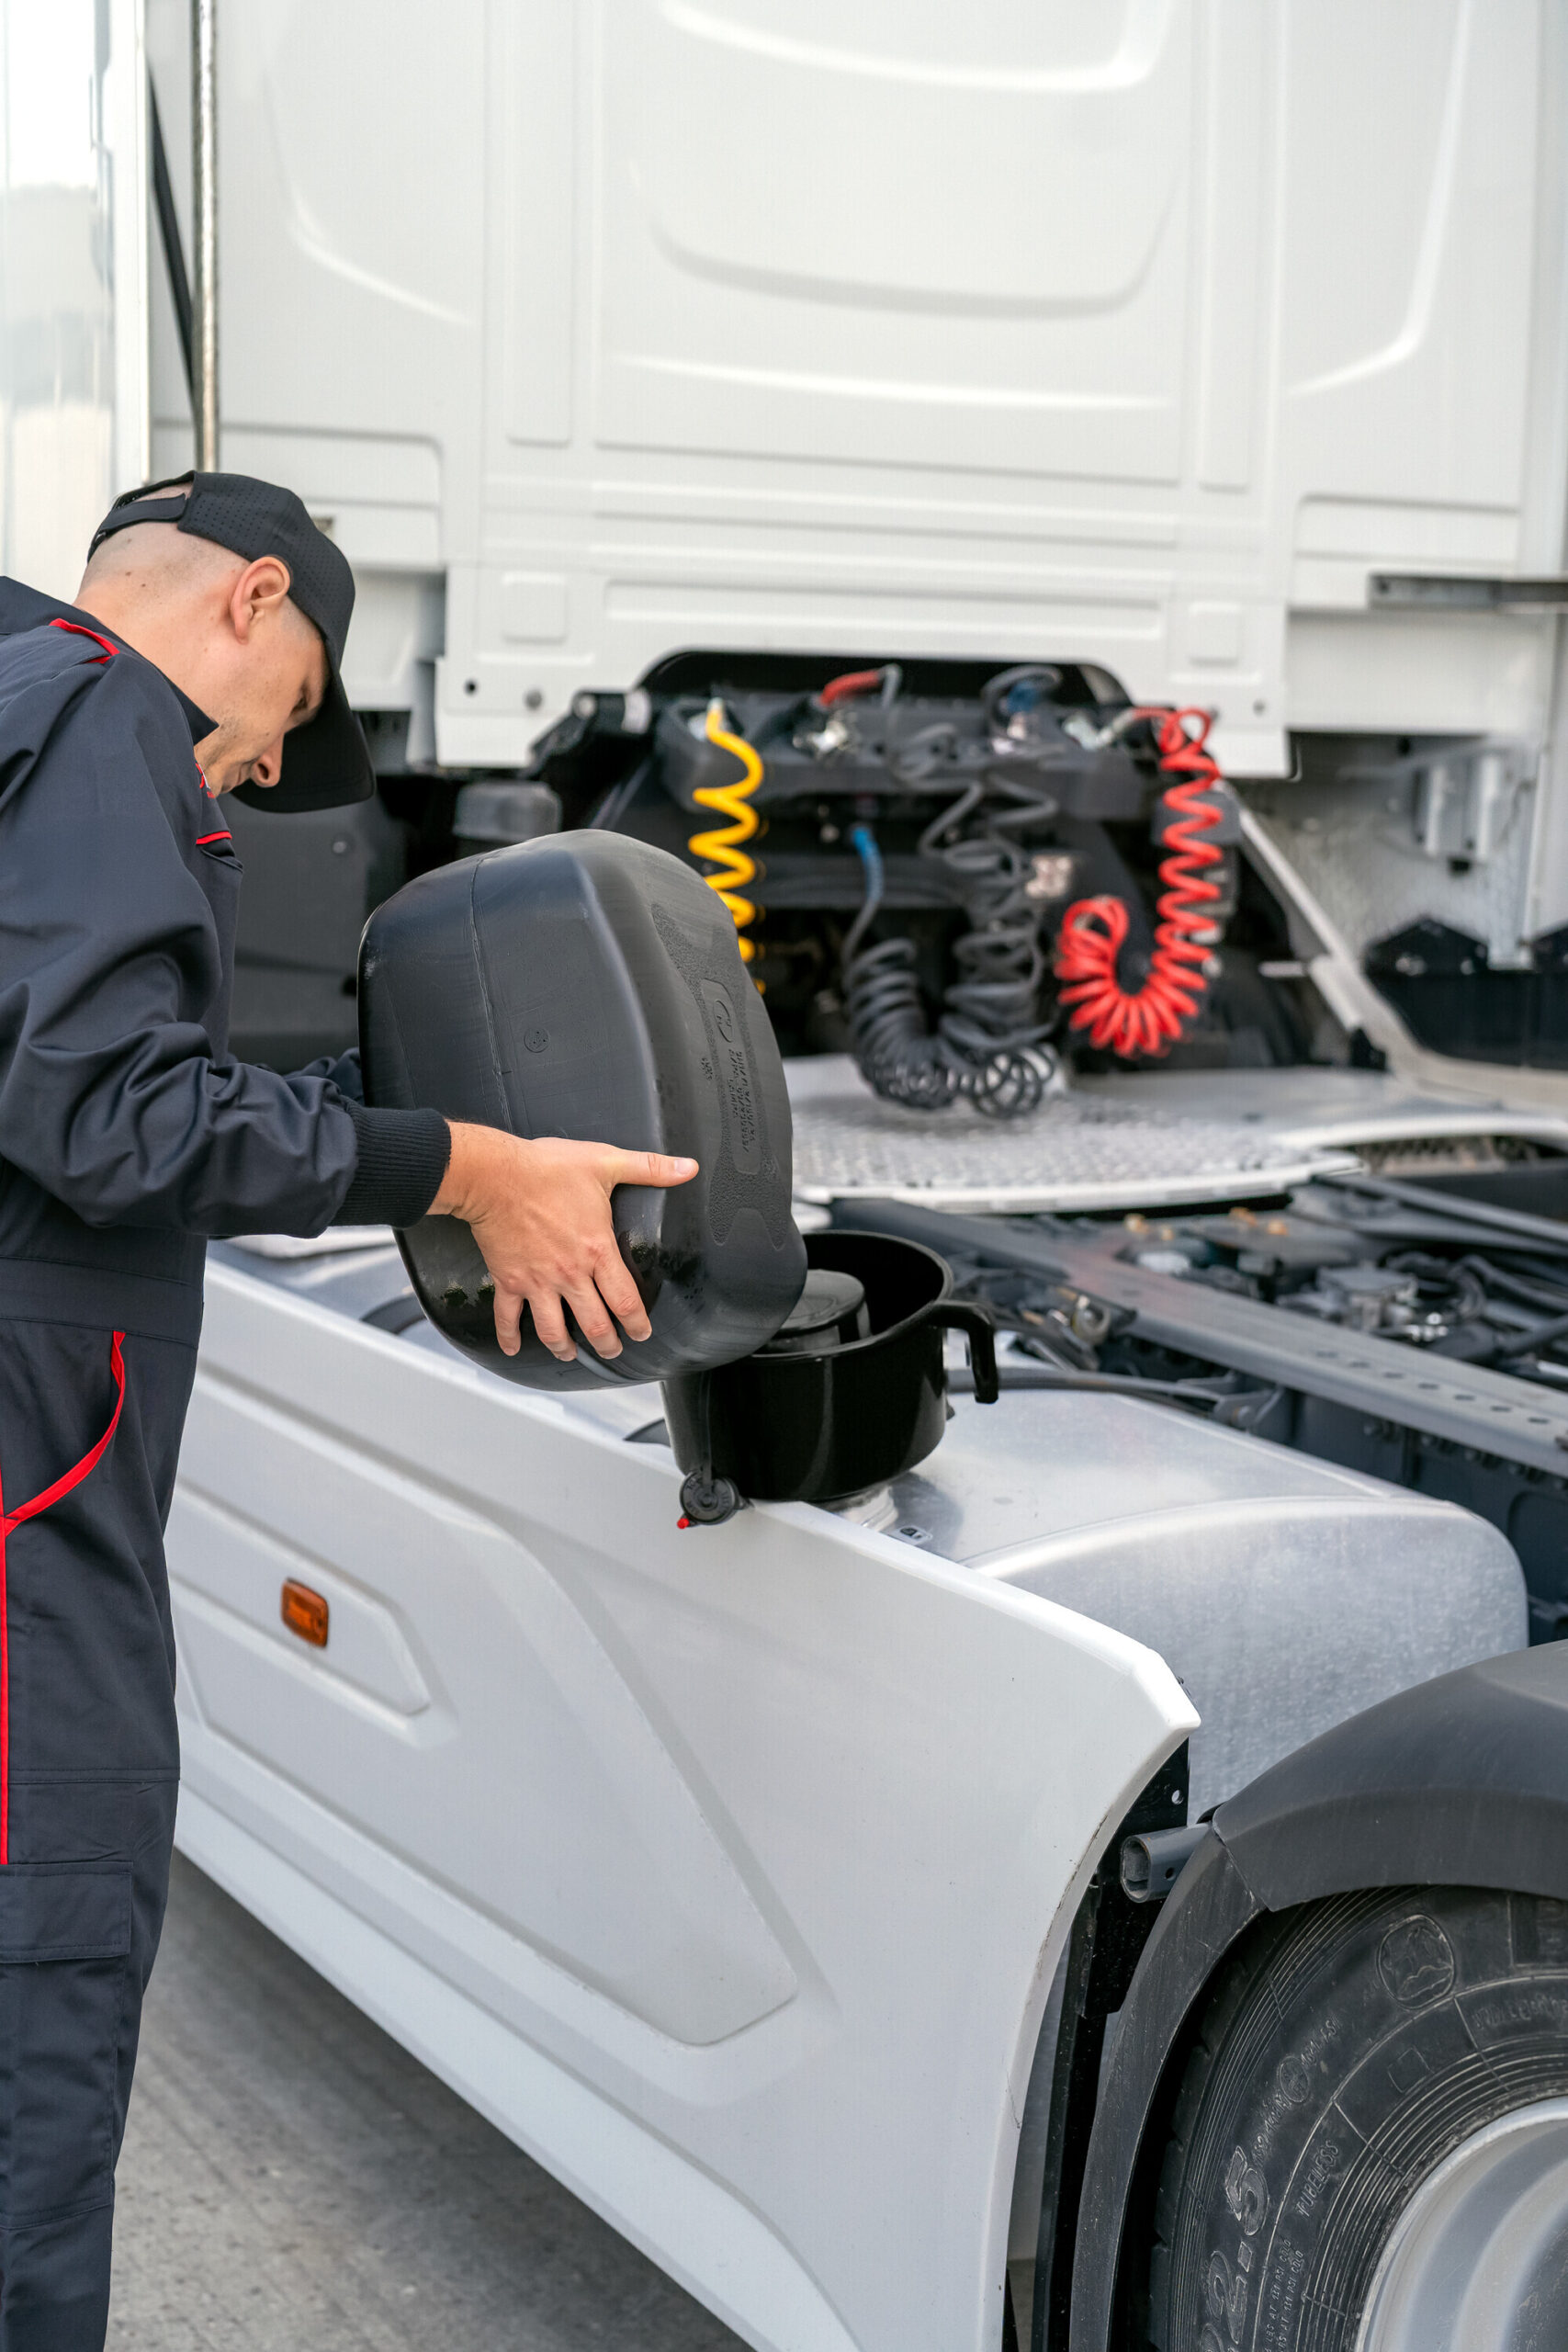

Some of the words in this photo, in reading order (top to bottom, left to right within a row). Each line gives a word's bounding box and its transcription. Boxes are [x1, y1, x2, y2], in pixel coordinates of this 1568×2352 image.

[1296, 2139, 1339, 2218] TUBELESS
[1279, 2239, 1292, 2264] COLD
[1291, 2249, 1304, 2275] COLD
[1275, 2265, 1285, 2283] PSI
[1286, 2277, 1298, 2295] PSI
[1269, 2304, 1278, 2321] AT
